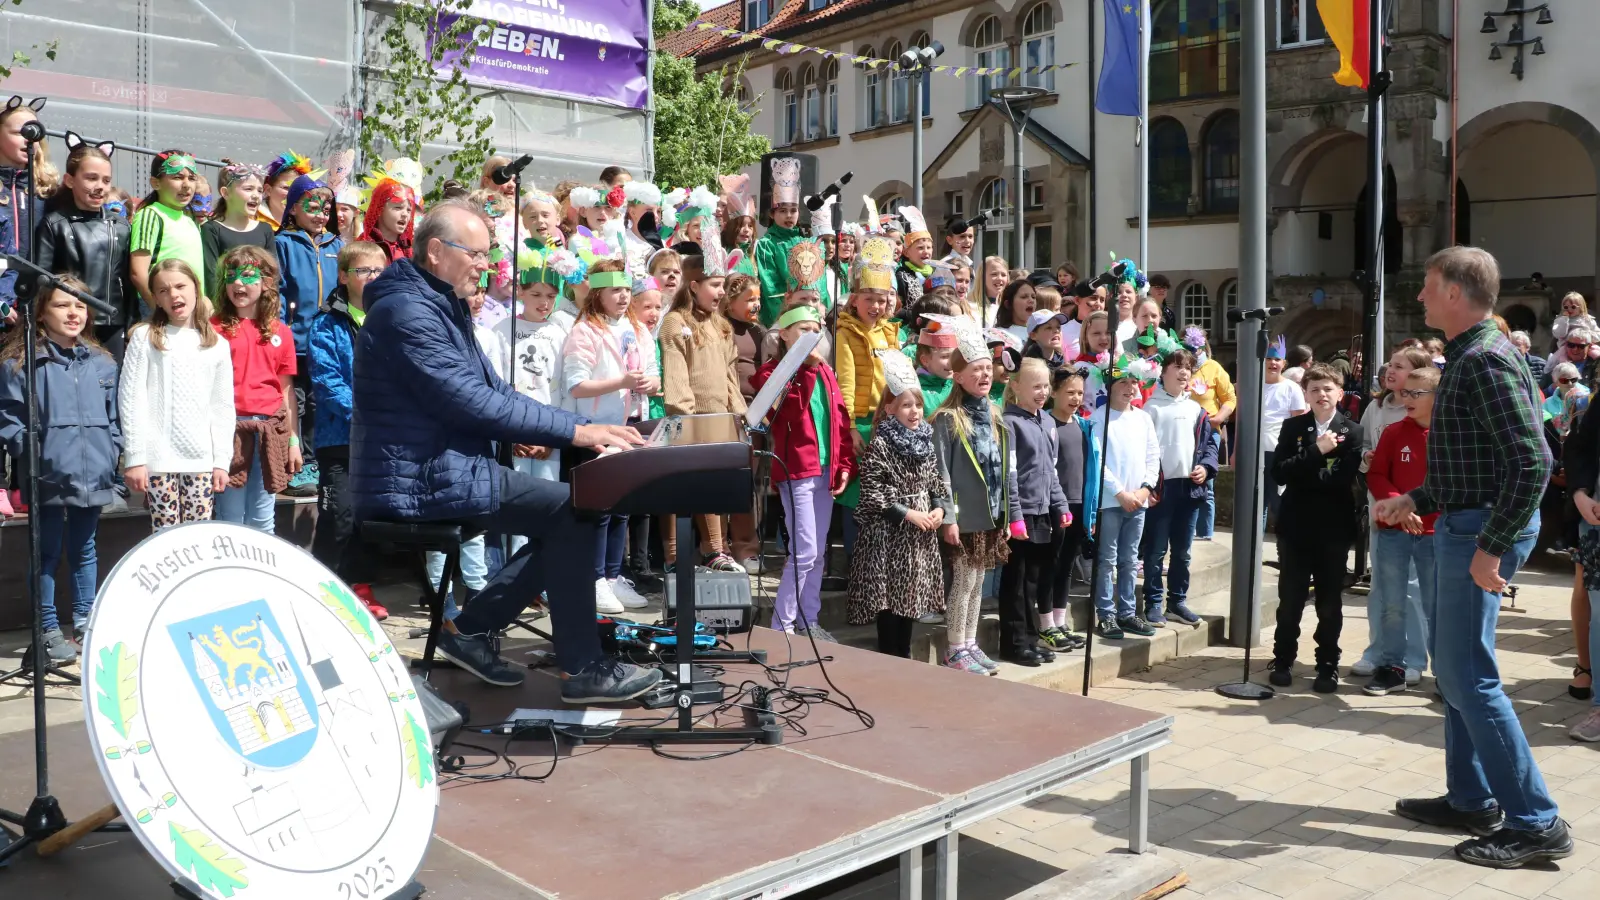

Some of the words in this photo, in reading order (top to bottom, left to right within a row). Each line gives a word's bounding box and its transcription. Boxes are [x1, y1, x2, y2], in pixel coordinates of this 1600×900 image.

[472, 24, 565, 61] GEBEN.
[469, 55, 549, 75] #KitasfürDemokratie
[91, 81, 147, 101] Layher
[1401, 453, 1410, 463] LA
[131, 544, 204, 594] Bester
[212, 535, 277, 568] Mann
[338, 856, 396, 900] 2025
